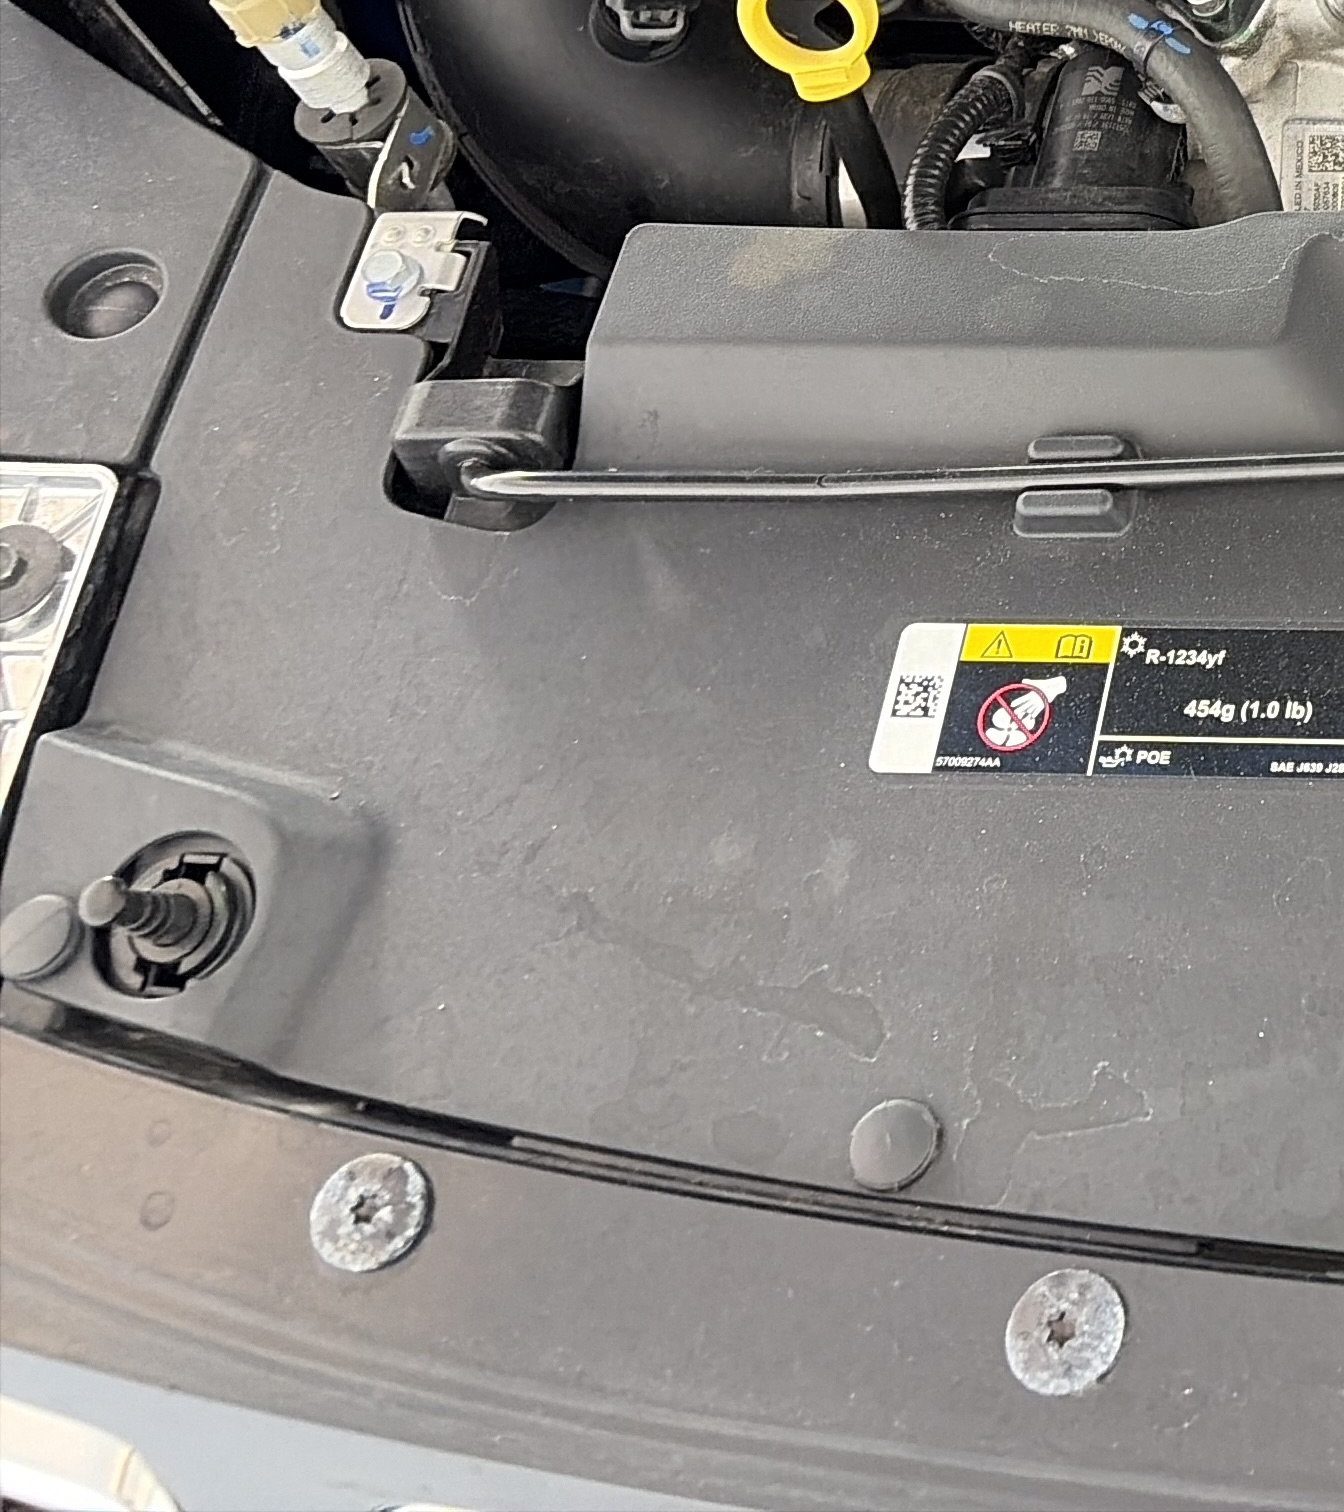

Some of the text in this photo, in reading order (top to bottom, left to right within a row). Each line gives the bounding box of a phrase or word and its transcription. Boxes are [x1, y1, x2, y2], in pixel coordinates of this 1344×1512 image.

[1295, 140, 1304, 178] MEXICO
[1145, 649, 1227, 669] R-1234yf
[1183, 700, 1313, 723] 454g (1.0 lb)
[935, 755, 1001, 768] 57009274AA
[1135, 750, 1172, 765] POE
[1269, 761, 1295, 773] SAE
